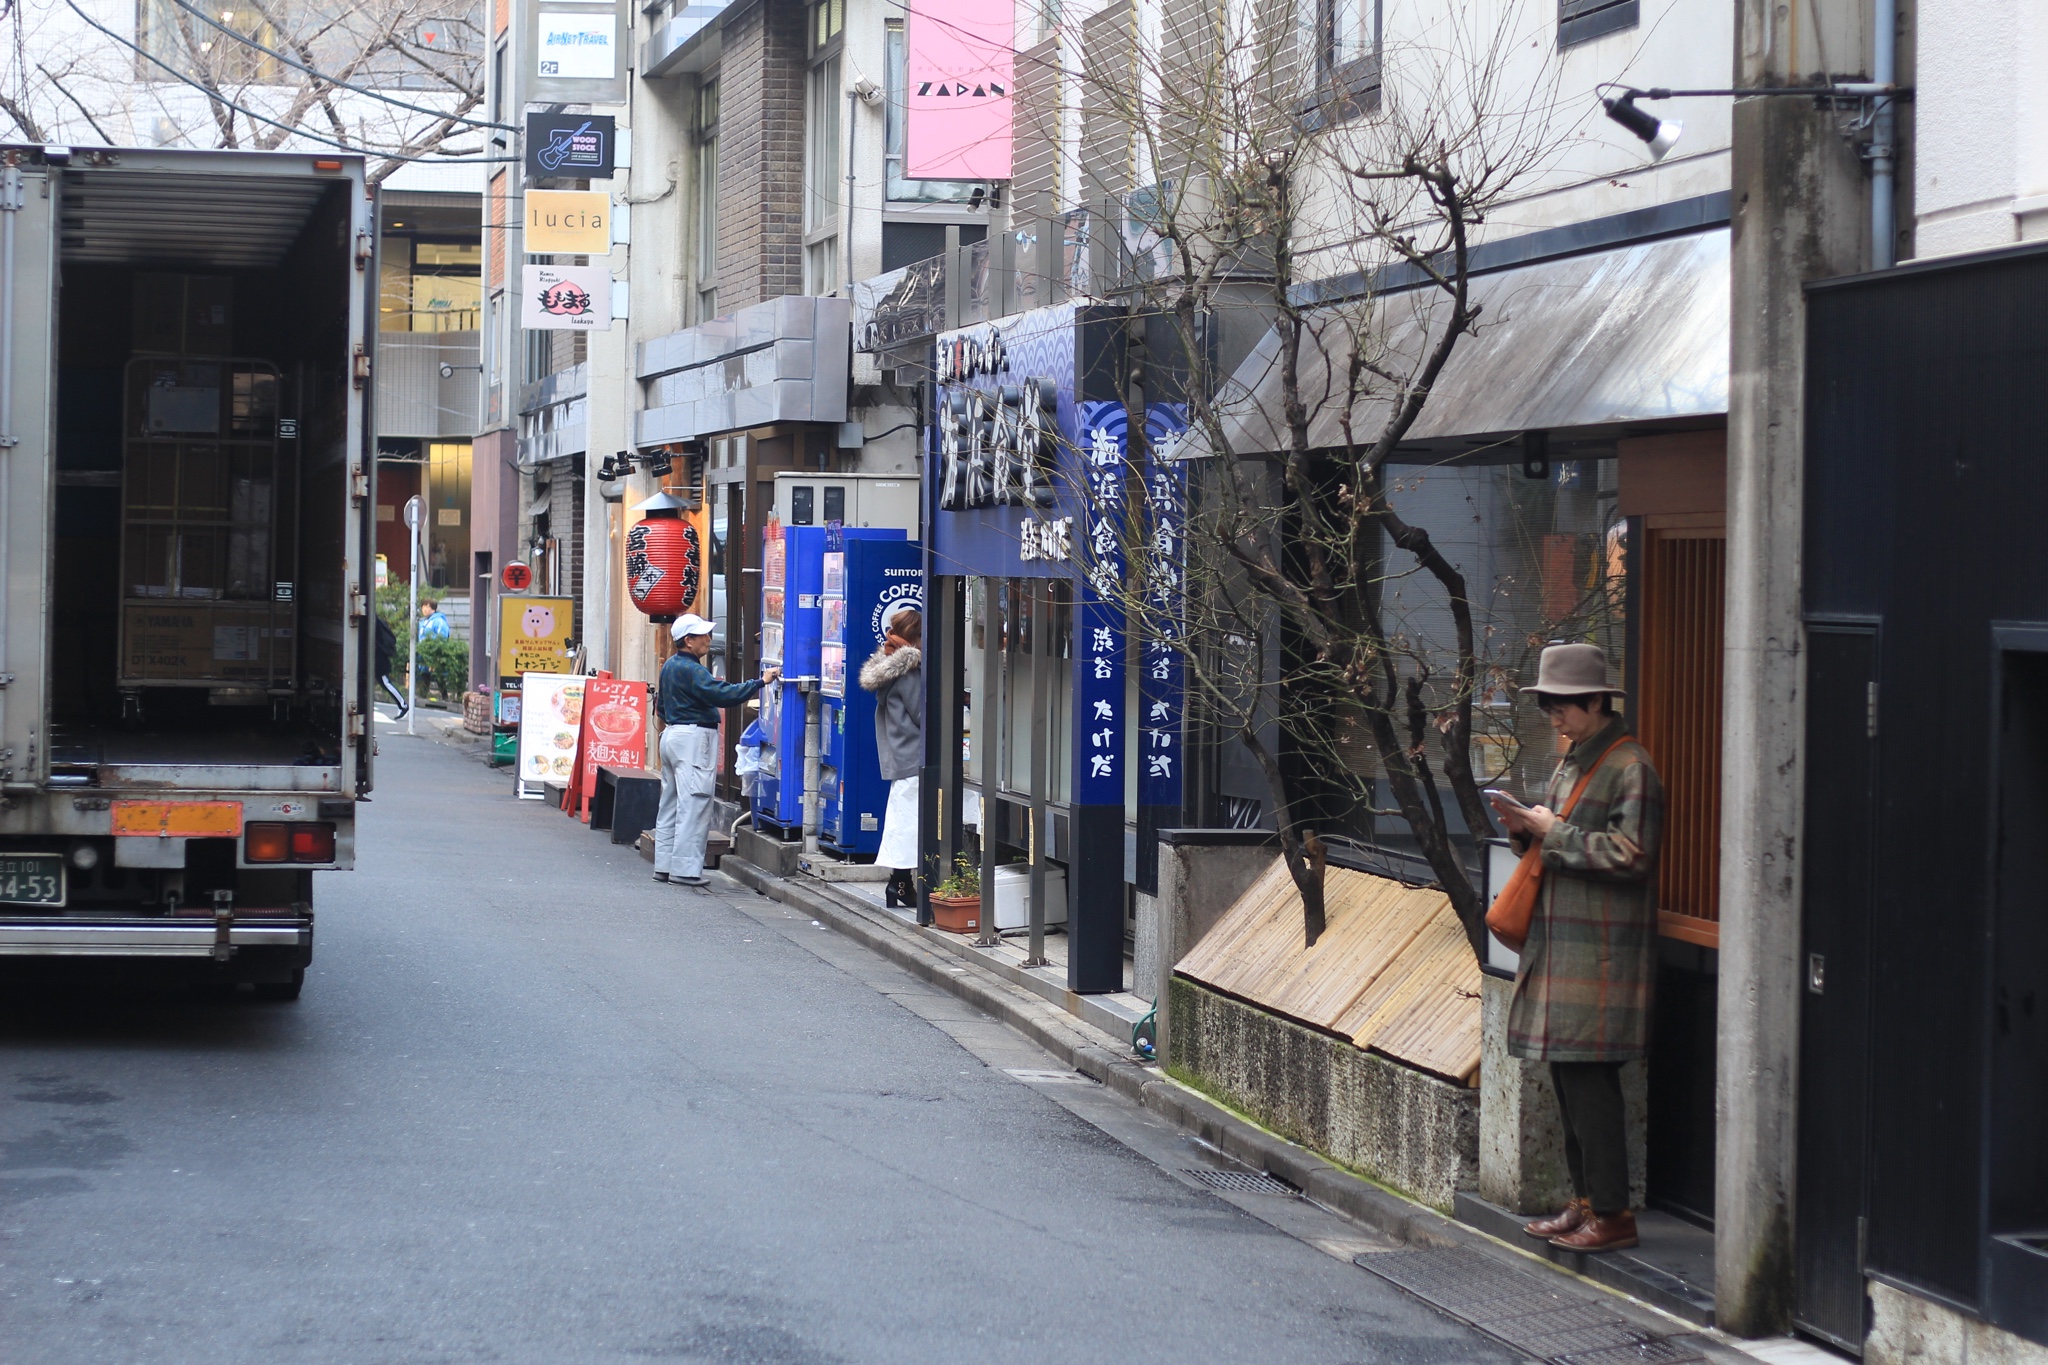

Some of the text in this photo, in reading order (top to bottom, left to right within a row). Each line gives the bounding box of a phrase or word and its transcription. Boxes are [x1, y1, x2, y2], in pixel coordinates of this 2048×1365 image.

[541, 62, 558, 74] 2F
[533, 209, 602, 229] lucia
[537, 290, 591, 309] ももまる
[571, 317, 594, 325] Izakaya
[507, 567, 525, 586] 辛
[884, 568, 922, 577] SUNTOR
[880, 583, 922, 603] COFFE
[148, 615, 193, 628] YAMAHA
[872, 603, 884, 633] COFFEE
[1092, 626, 1115, 679] 渋谷
[1091, 699, 1115, 778] たけだ
[587, 740, 640, 764] 麺大盛り
[21, 861, 39, 873] 101
[0, 875, 56, 898] 4-53
